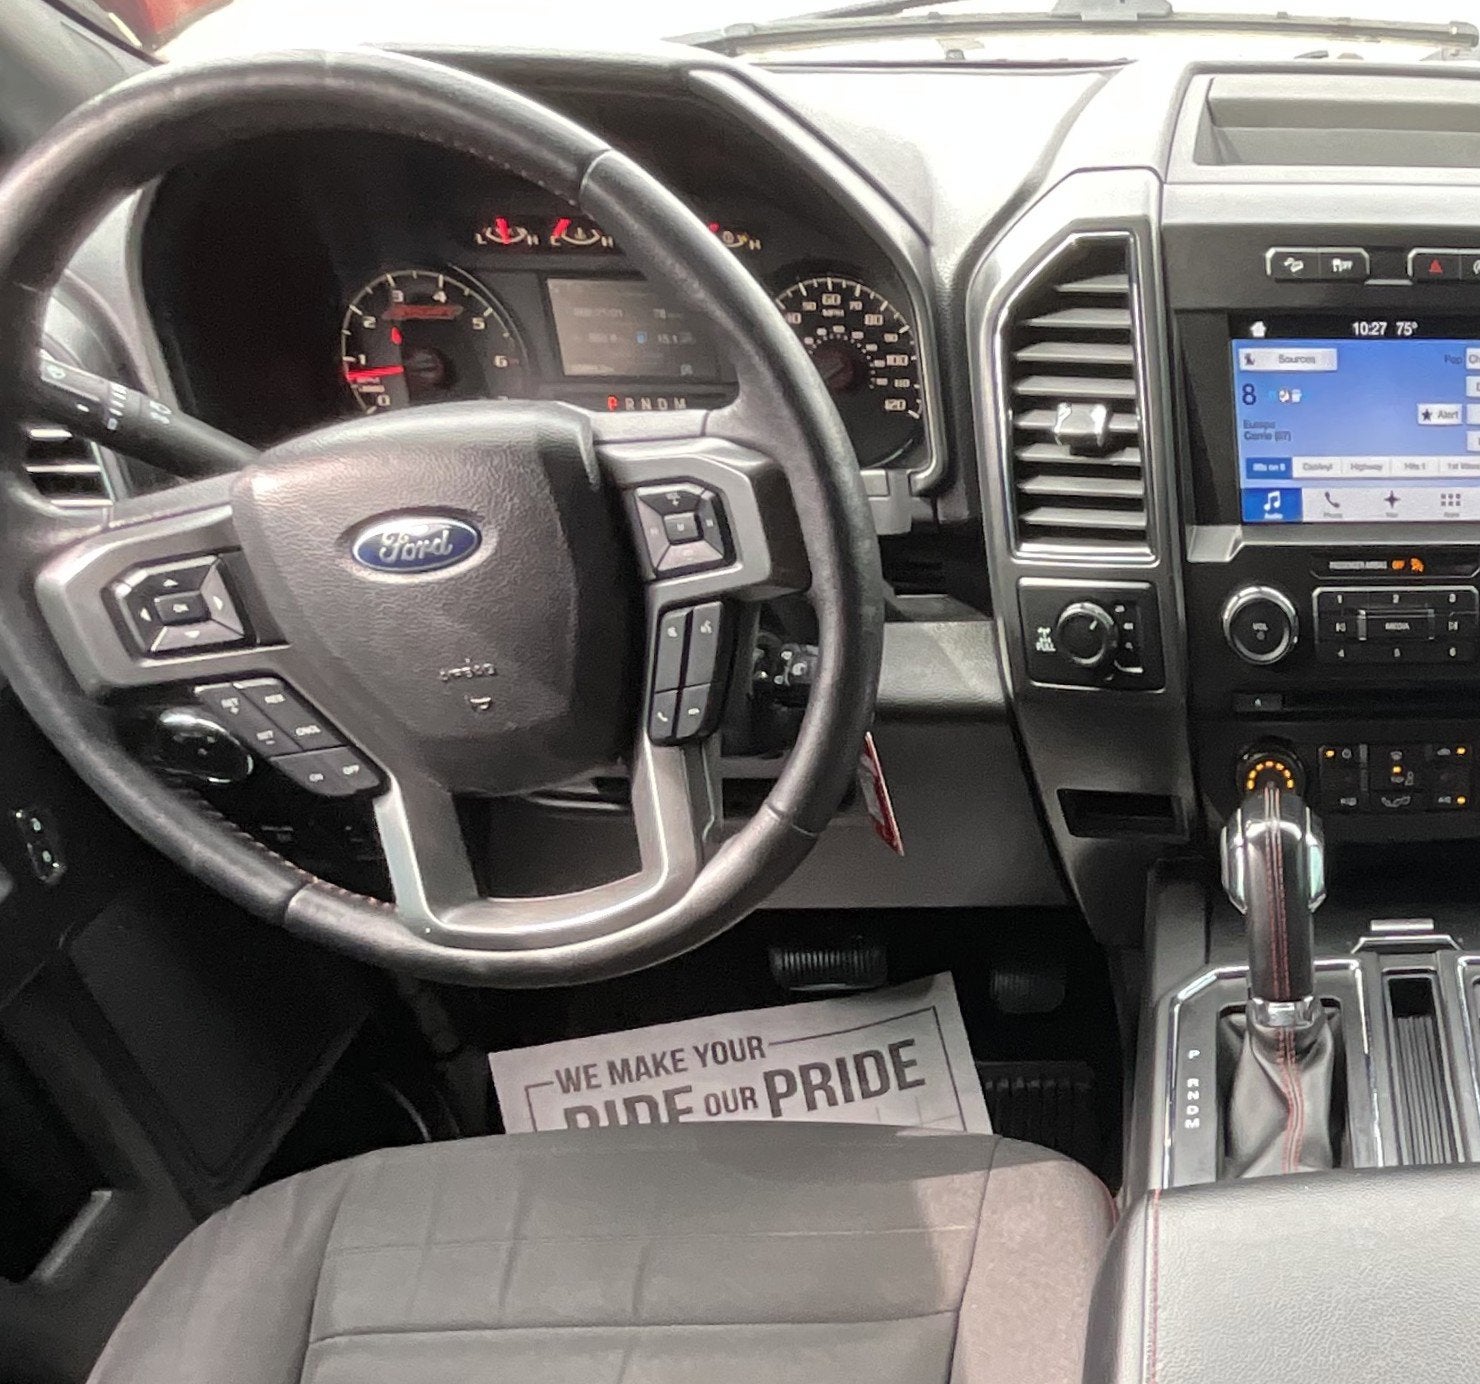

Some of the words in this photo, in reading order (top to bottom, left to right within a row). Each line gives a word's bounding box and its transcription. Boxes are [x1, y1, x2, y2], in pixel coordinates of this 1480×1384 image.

[432, 290, 447, 303] 4
[821, 293, 842, 306] 60
[849, 301, 863, 311] 70
[362, 316, 376, 329] 2
[472, 316, 486, 330] 5
[864, 313, 884, 326] 80
[1352, 322, 1387, 336] 10:27
[358, 354, 367, 365] 1
[493, 355, 508, 368] 6
[886, 354, 909, 367] 100
[1278, 354, 1316, 364] Sources
[1242, 383, 1257, 405] 8
[624, 397, 635, 410] R
[640, 397, 652, 410] N
[656, 397, 668, 410] D
[674, 397, 687, 409] M
[884, 398, 907, 411] 120
[1437, 409, 1459, 420] Alert
[379, 527, 453, 565] Ford
[1188, 1049, 1201, 1060] P
[555, 1062, 598, 1094] WE
[606, 1048, 688, 1088] MAKE
[692, 1035, 767, 1068] YOUR
[703, 1085, 759, 1117] OUR
[762, 1037, 926, 1119] PRIDE
[1187, 1078, 1200, 1088] R
[1187, 1090, 1200, 1101] N
[1186, 1105, 1200, 1116] D
[1184, 1117, 1201, 1129] M
